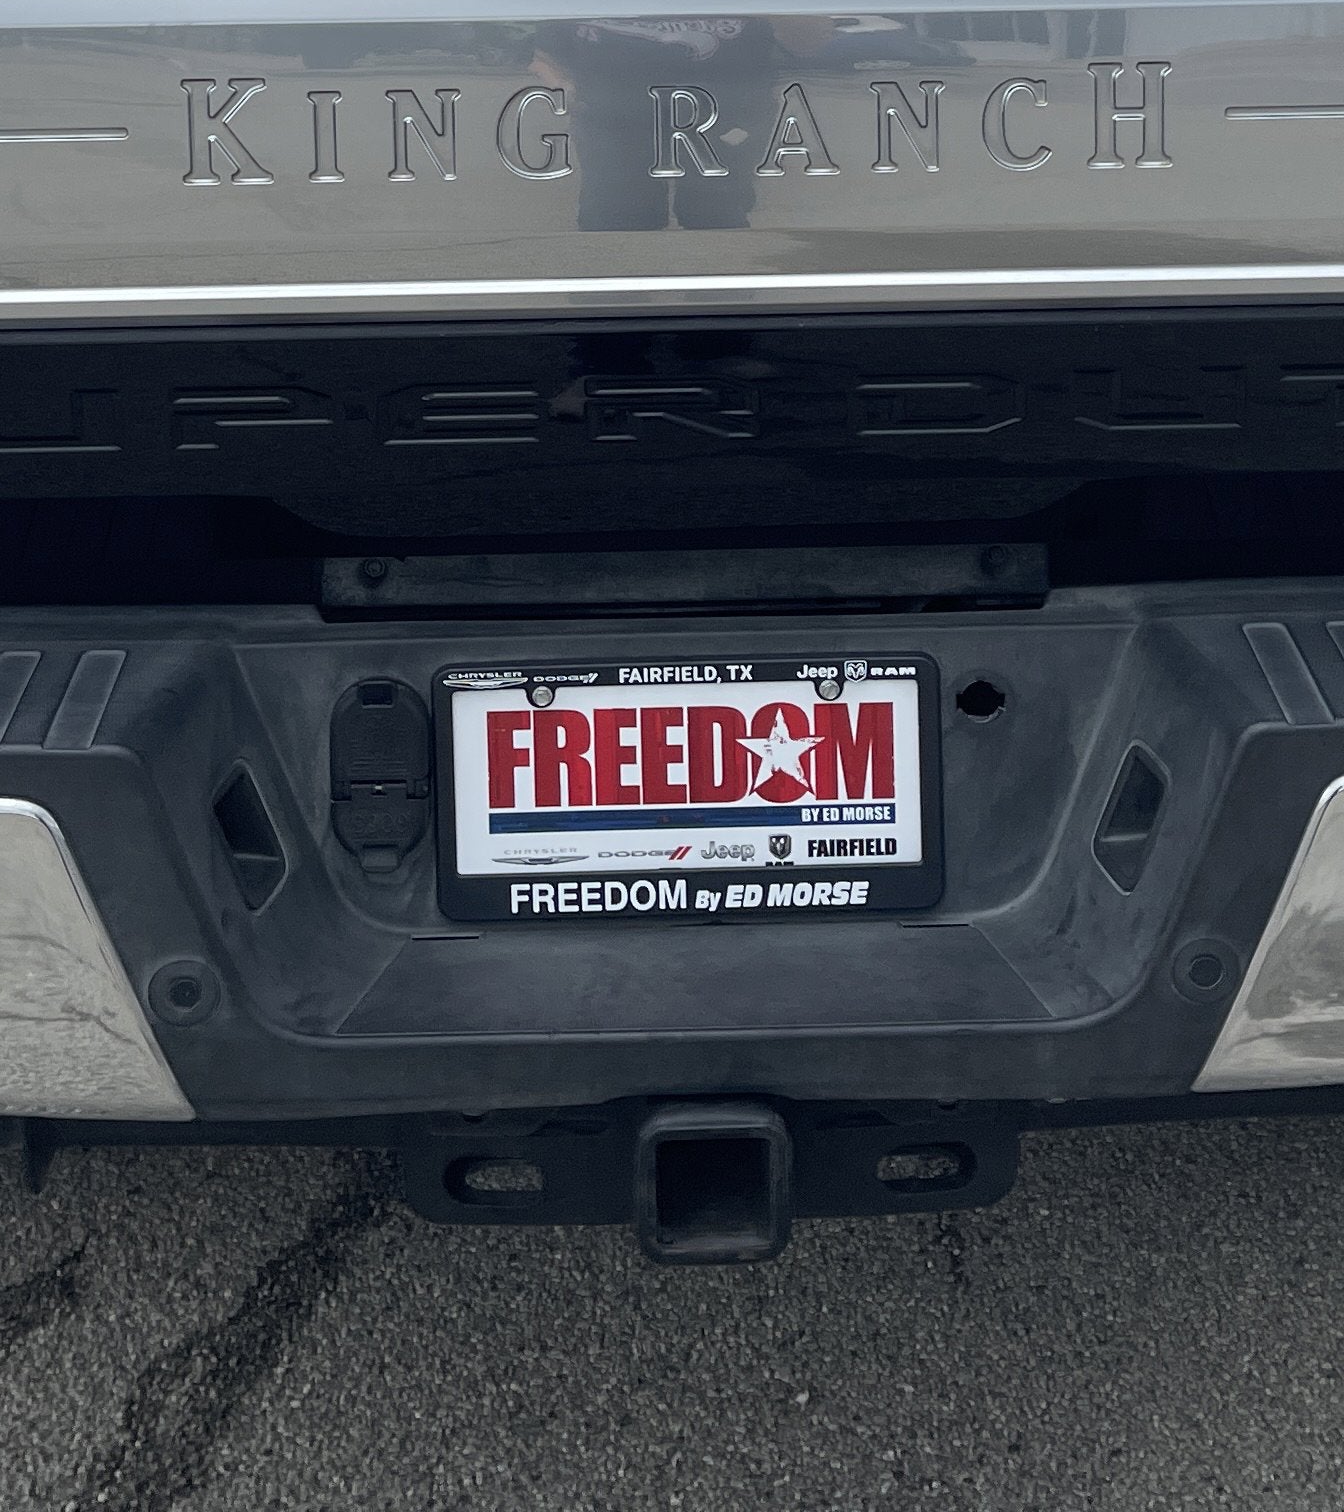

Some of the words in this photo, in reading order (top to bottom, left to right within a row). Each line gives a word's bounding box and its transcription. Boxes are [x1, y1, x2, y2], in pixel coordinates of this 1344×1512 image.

[179, 76, 575, 186] KING
[649, 61, 1174, 178] RANCH
[448, 671, 522, 680] CHRYSLER
[618, 665, 722, 684] FAIRFIELD,
[726, 664, 753, 681] TX
[796, 664, 838, 679] Jeep
[870, 666, 916, 676] RAM
[486, 701, 895, 809] FREEDOM
[801, 808, 821, 823] BY
[822, 807, 840, 822] ED
[842, 806, 891, 821] MORSE
[503, 846, 578, 856] CHRYSLER
[701, 840, 755, 861] Jeep
[807, 837, 897, 857] FAIRFIELD
[510, 878, 688, 914] FREEDOM
[695, 890, 721, 912] By
[725, 883, 762, 908] ED
[766, 880, 869, 907] MORSE
